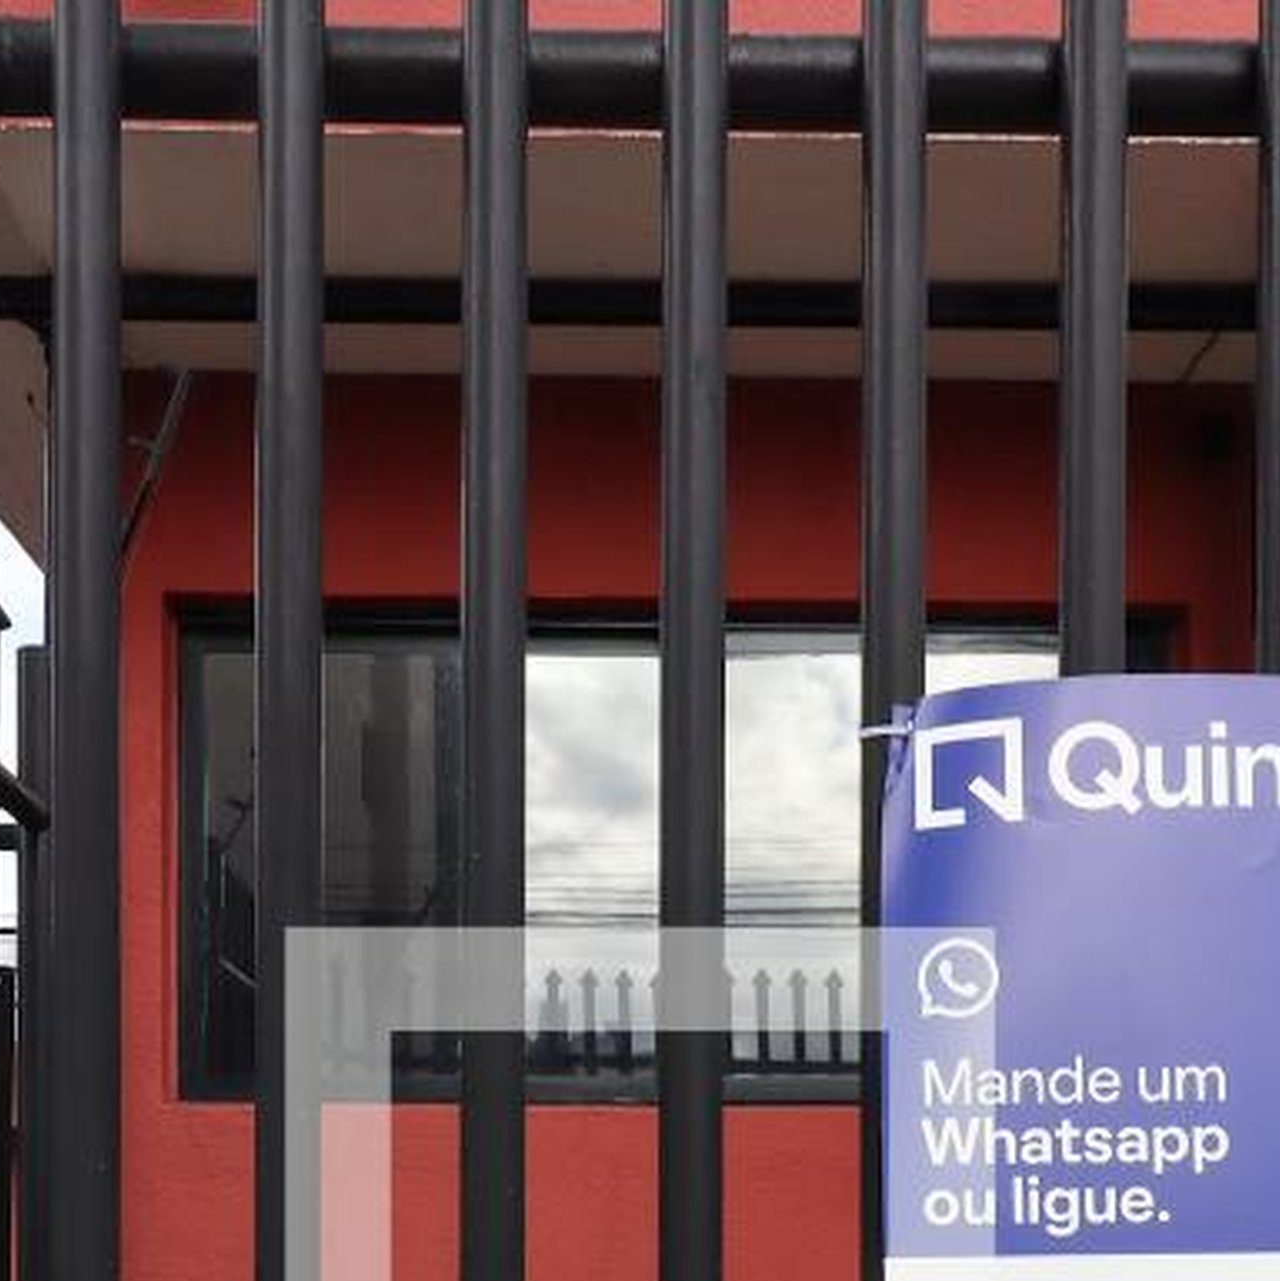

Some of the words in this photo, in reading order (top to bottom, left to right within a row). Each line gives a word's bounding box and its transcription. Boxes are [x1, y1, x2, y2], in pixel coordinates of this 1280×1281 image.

[921, 1055, 1121, 1107] Mande
[1137, 1063, 1227, 1103] um
[921, 1116, 1230, 1175] Whatsapp
[922, 1188, 997, 1226] ou
[1013, 1173, 1171, 1238] ligue.
